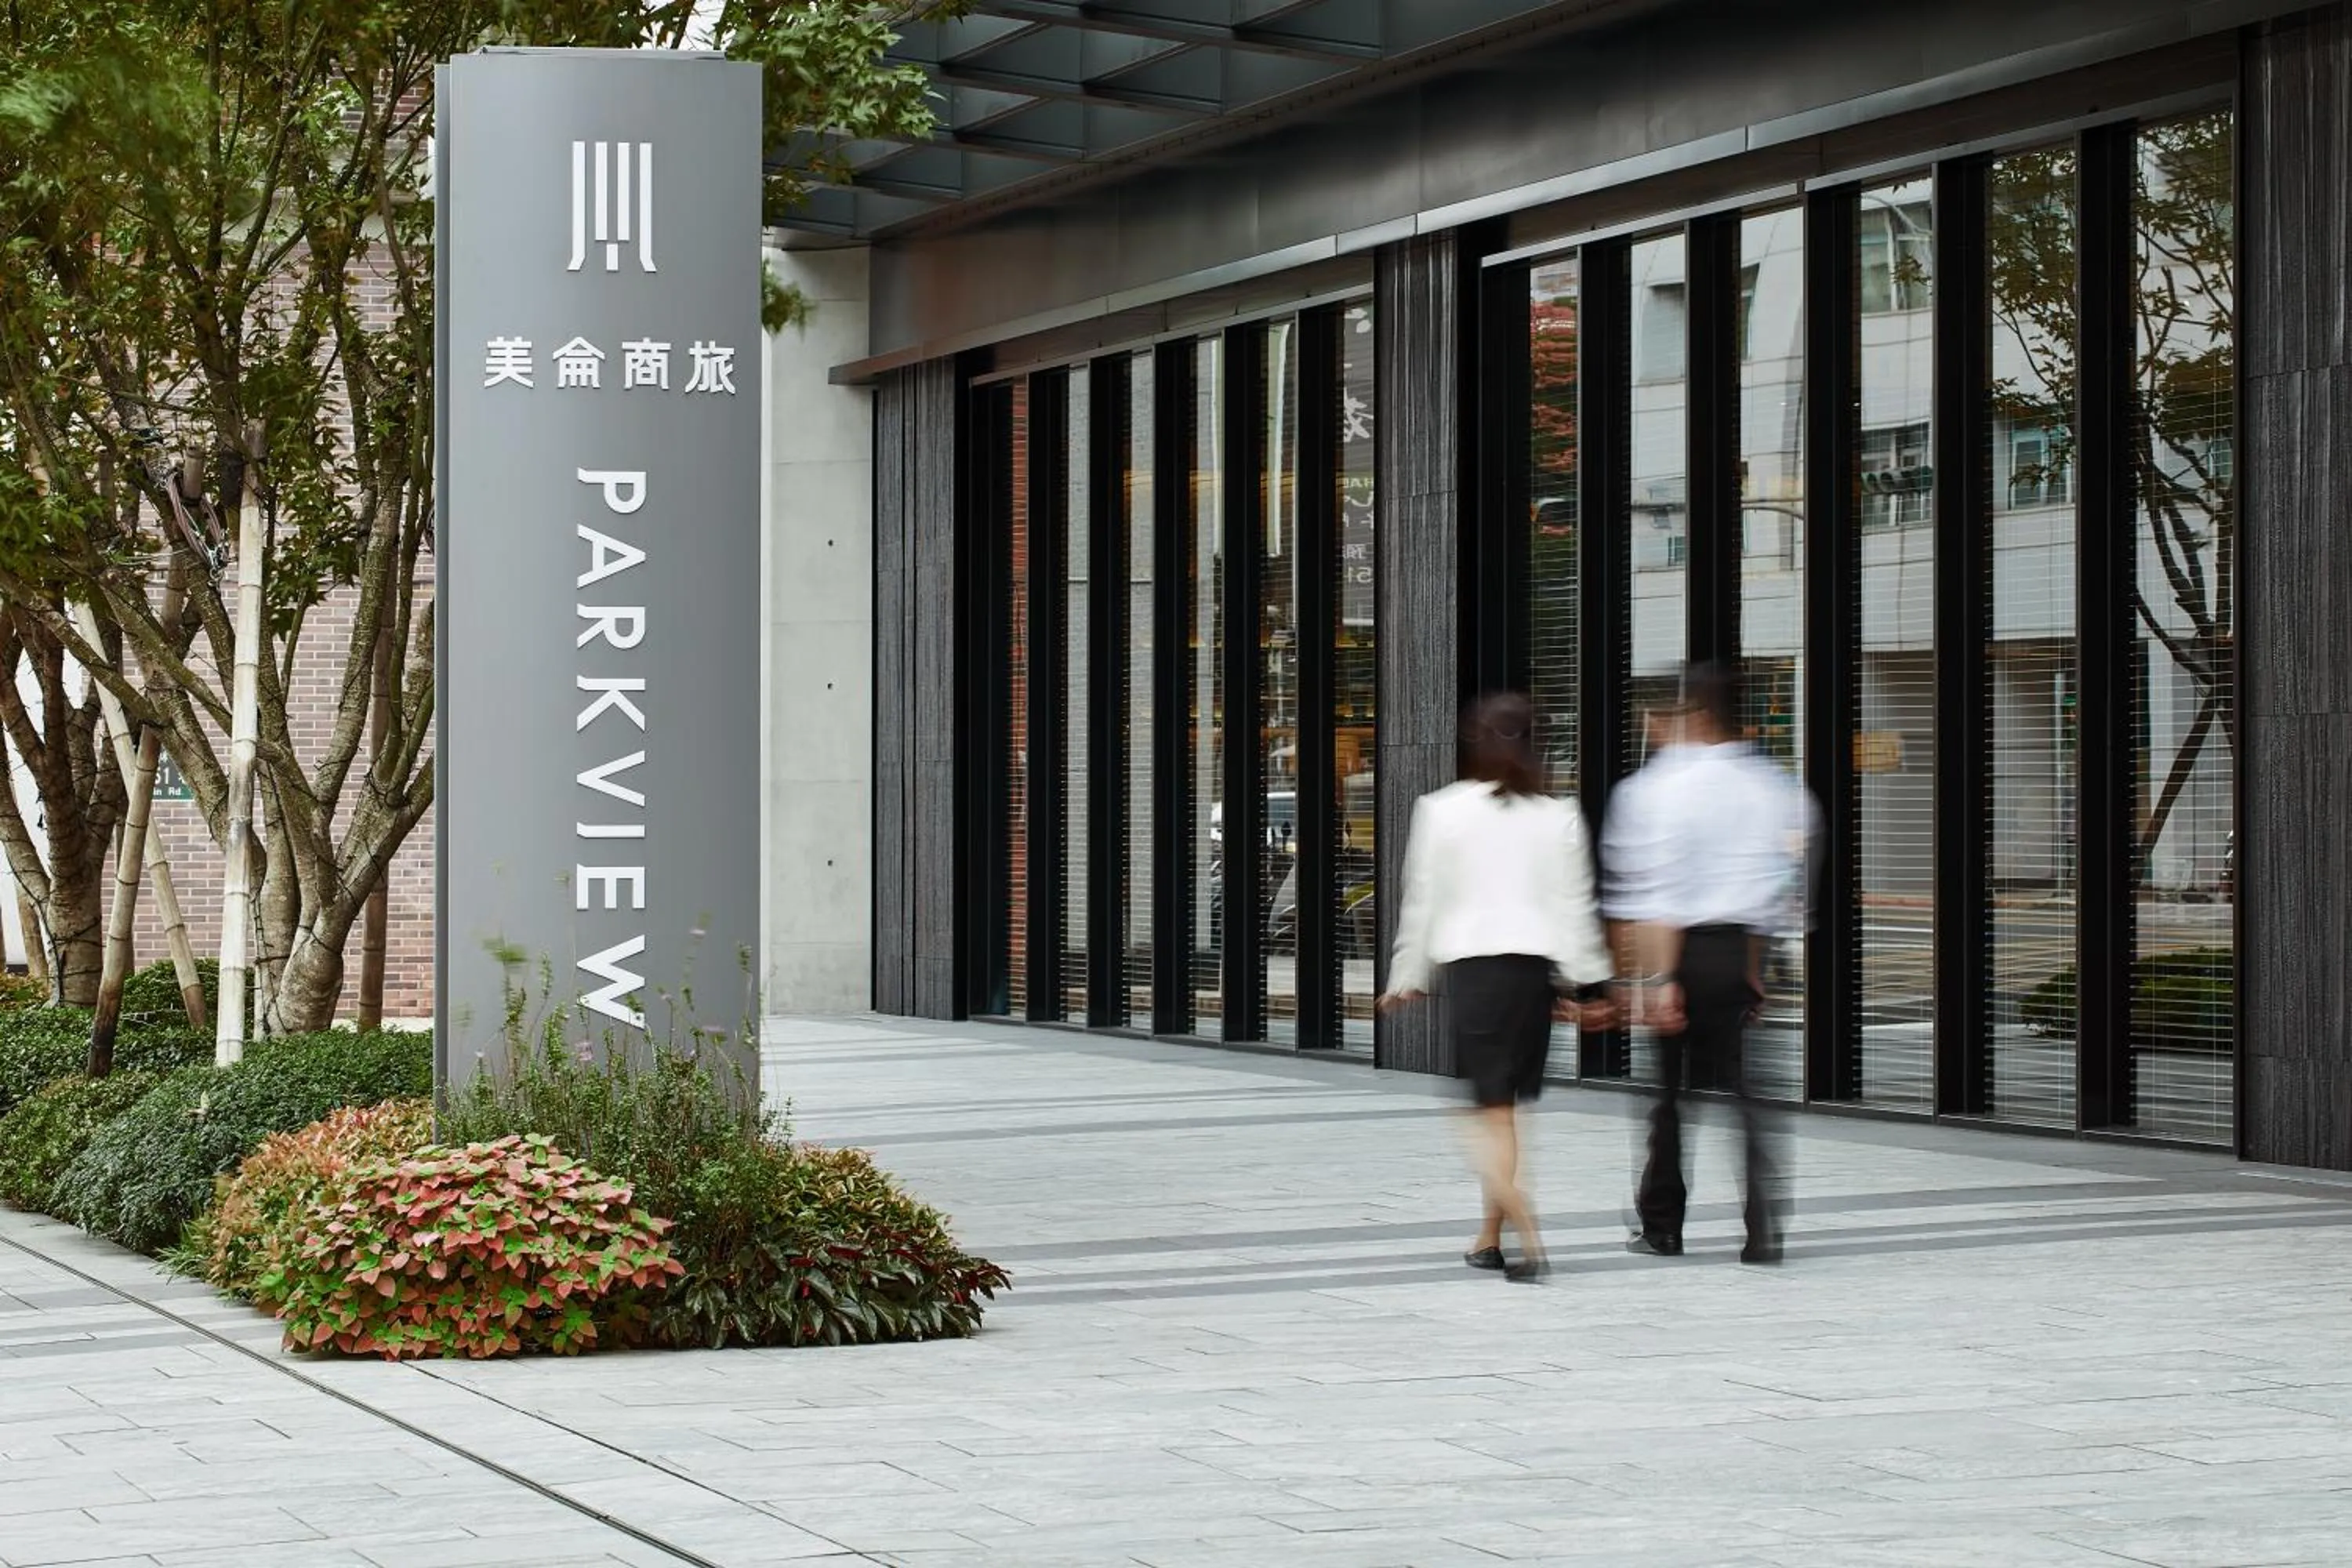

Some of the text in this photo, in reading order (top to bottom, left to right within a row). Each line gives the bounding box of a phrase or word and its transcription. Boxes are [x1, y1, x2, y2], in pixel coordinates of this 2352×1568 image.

[484, 336, 736, 394] 美侖商旅
[576, 467, 647, 1029] PARKVIEW
